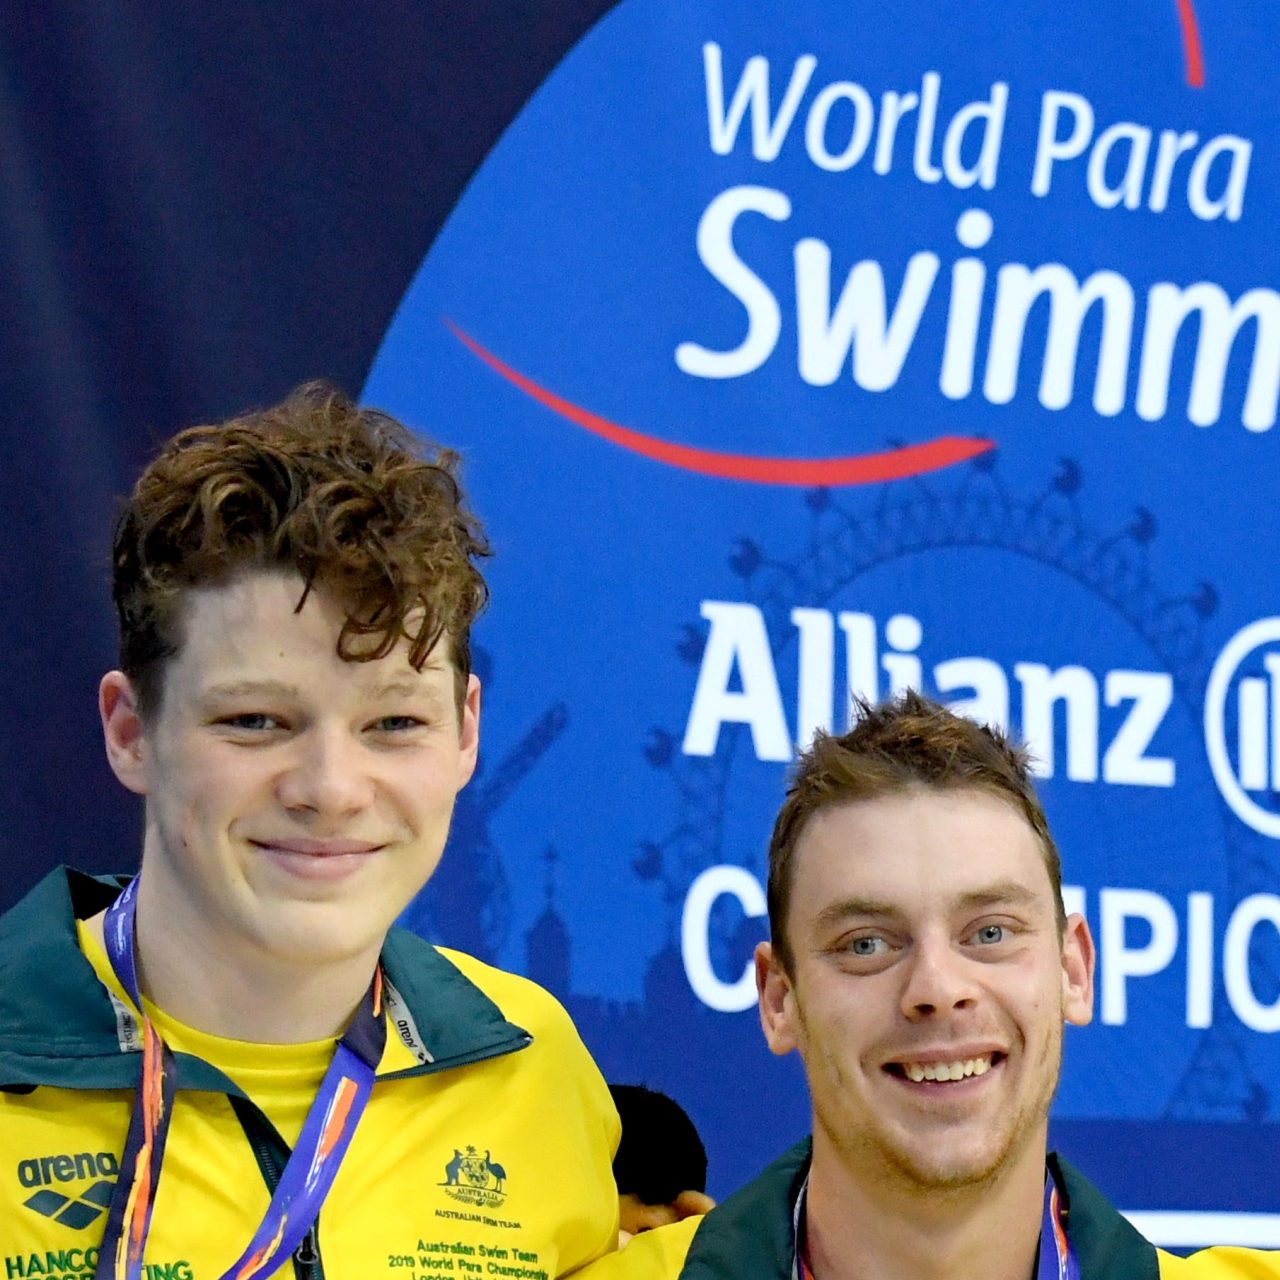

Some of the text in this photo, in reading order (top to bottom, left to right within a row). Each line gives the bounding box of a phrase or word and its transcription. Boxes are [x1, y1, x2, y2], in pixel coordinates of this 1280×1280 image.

[703, 41, 1252, 222] World Para
[18, 1152, 119, 1188] arena
[457, 1187, 498, 1201] AUSTRALIA
[435, 1209, 481, 1223] AUSTRALIAN
[417, 1239, 538, 1263] Australian Swim Team
[5, 1247, 101, 1280] HANCO
[388, 1255, 415, 1268] 2019
[419, 1256, 453, 1270] World
[458, 1259, 482, 1273] Para
